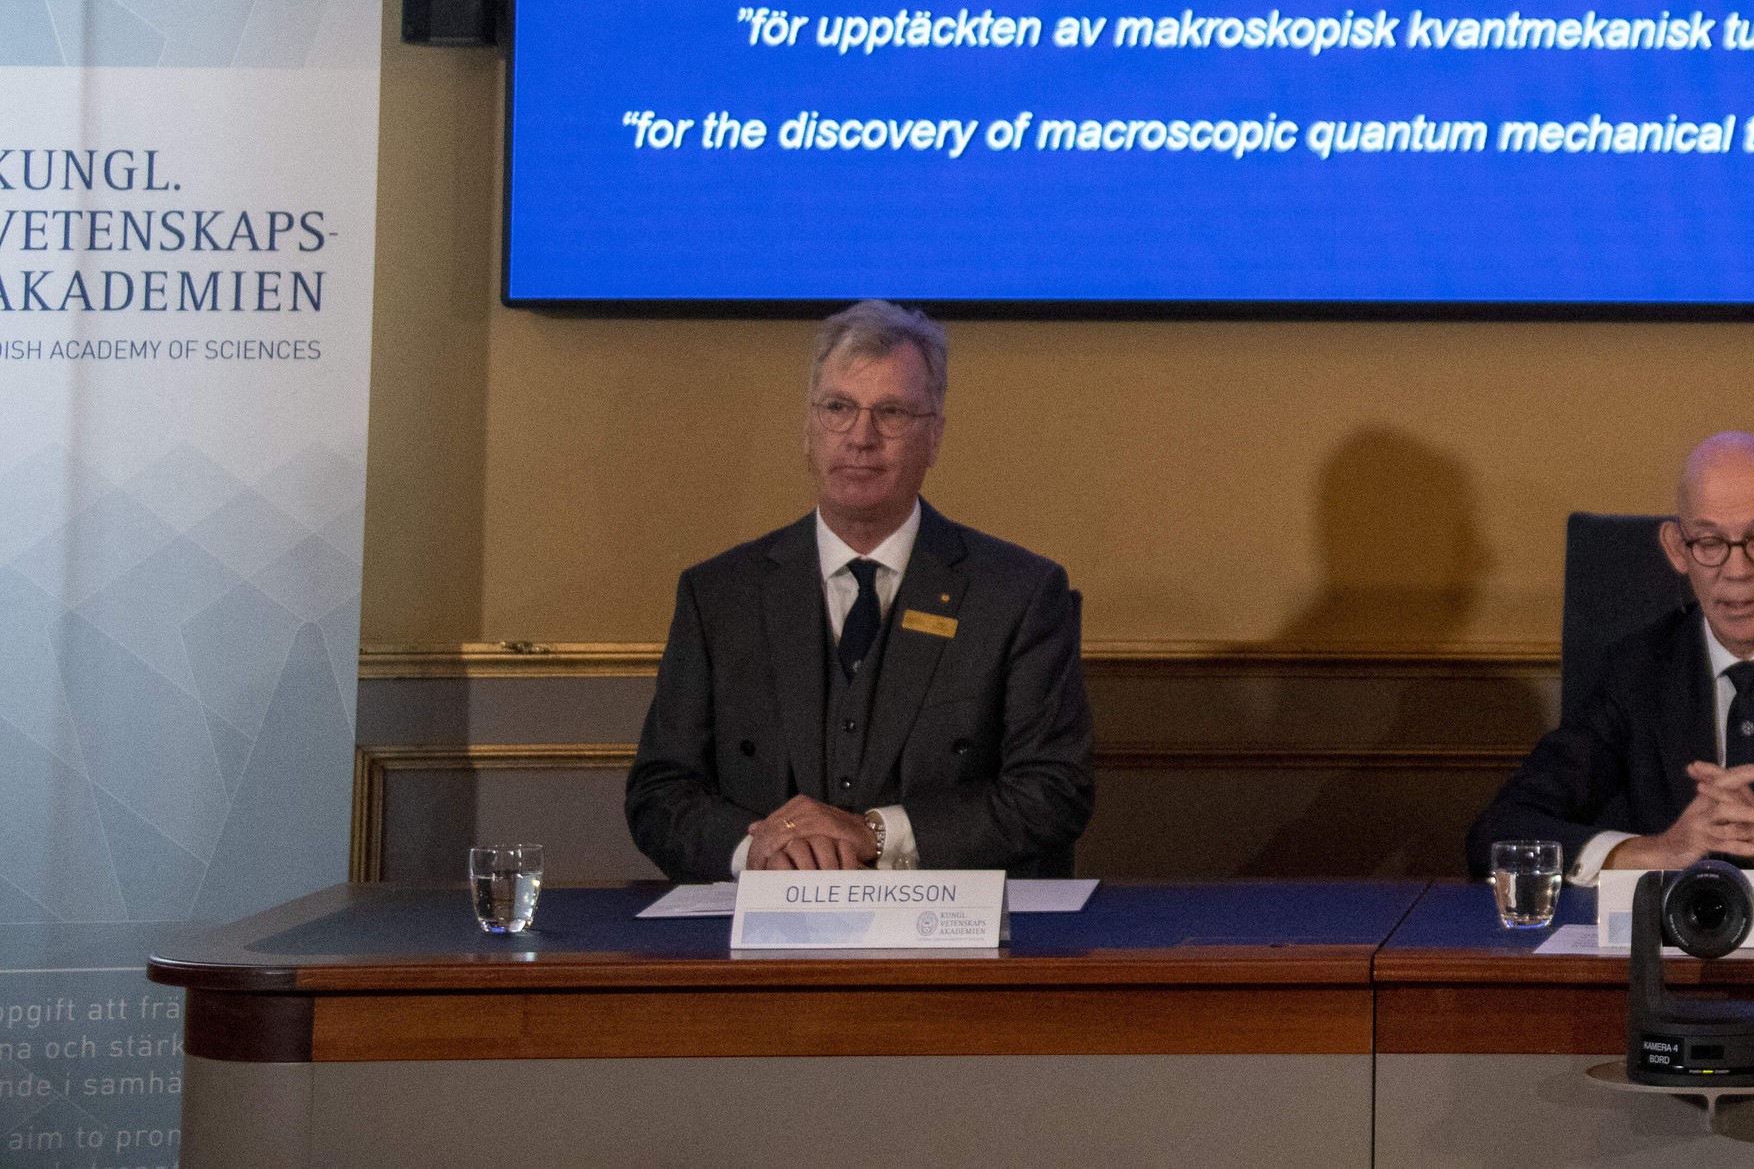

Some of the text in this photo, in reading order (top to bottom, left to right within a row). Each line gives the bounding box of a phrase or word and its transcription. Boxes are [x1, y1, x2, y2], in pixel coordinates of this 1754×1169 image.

[816, 7, 1043, 55] upptäckten
[1053, 16, 1108, 48] av
[1113, 8, 1401, 57] makroskopisk
[1407, 9, 1717, 51] kvantmekanisk
[701, 110, 768, 150] the
[778, 110, 980, 159] discovery
[985, 110, 1033, 151] of
[1036, 110, 1300, 160] macroscopic
[1307, 113, 1489, 159] quantum
[1498, 113, 1737, 154] mechanical
[49, 339, 162, 361] ACADEMY
[168, 339, 199, 361] OF
[204, 339, 322, 361] SCIENCES
[785, 884, 957, 904] OLLE ERIKSSON
[0, 995, 180, 1029] pgift att frä
[44, 1033, 97, 1060] och
[1643, 1040, 1679, 1053] KAMERA 4
[1649, 1054, 1671, 1065] BORD
[8, 1125, 63, 1151] aim
[76, 1126, 104, 1149] to
